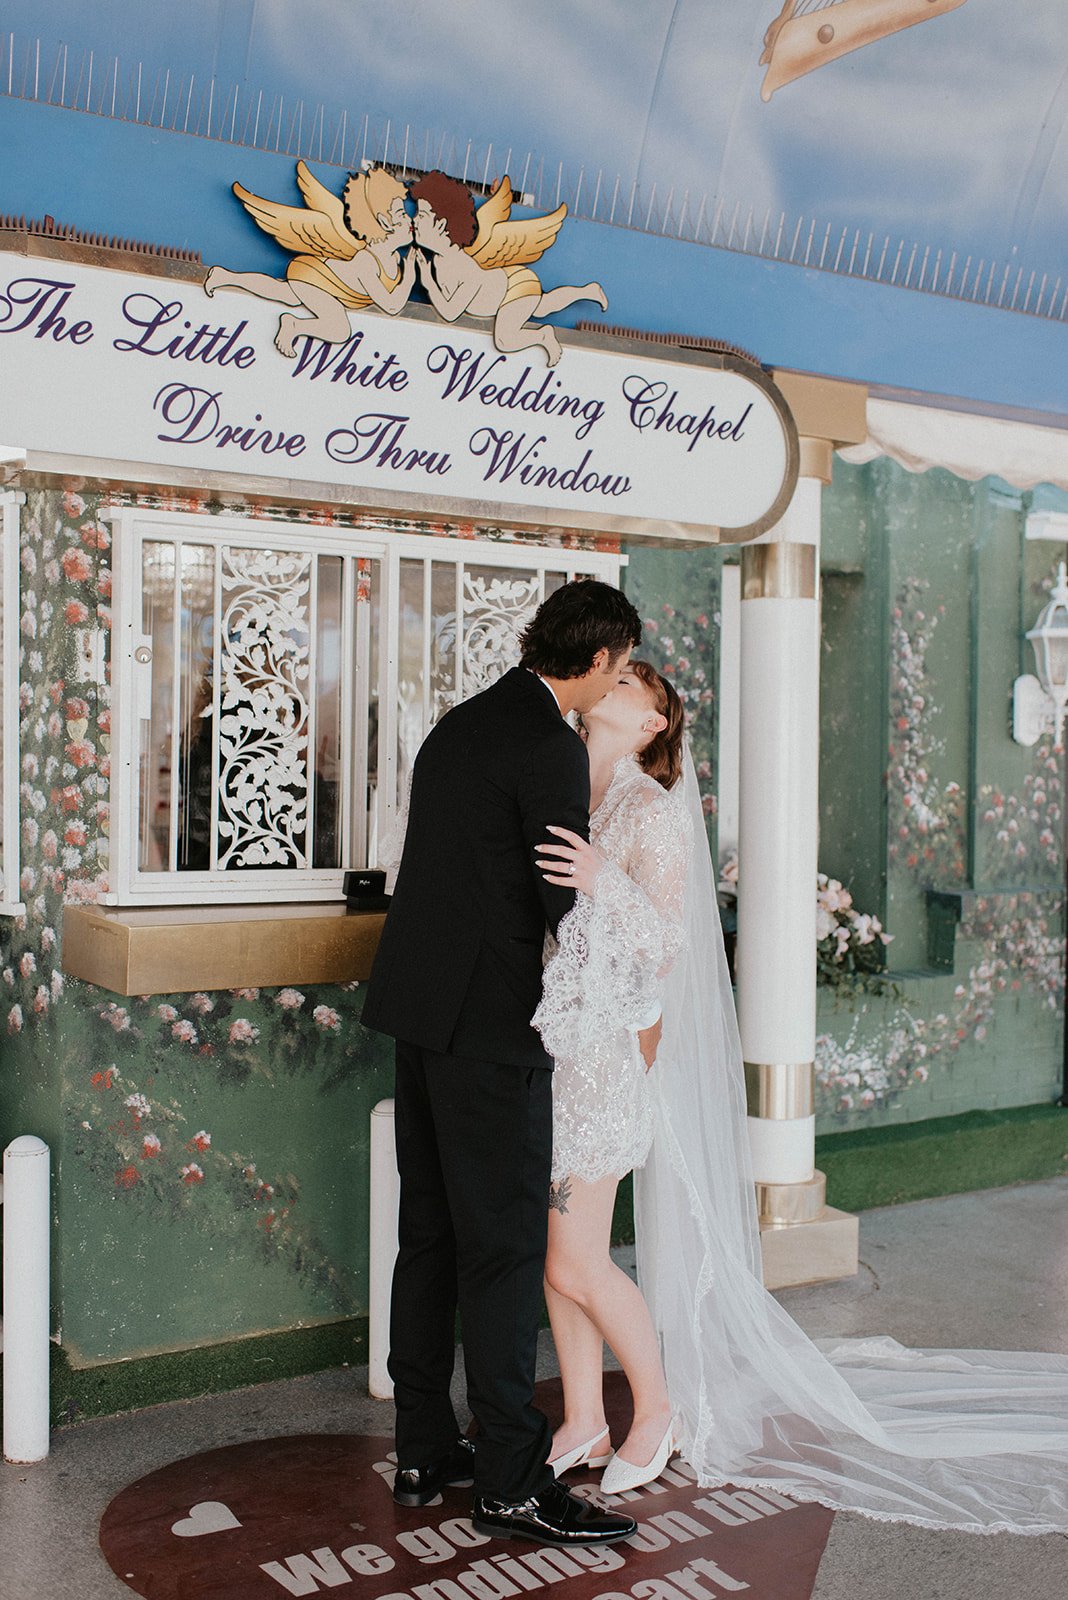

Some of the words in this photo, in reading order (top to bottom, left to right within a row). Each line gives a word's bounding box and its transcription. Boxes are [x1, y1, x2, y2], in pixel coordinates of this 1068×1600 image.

[0, 278, 94, 345] The
[113, 293, 256, 369] Little
[291, 331, 409, 392] White
[426, 345, 605, 440] Wedding
[622, 375, 754, 452] Chapel
[153, 382, 307, 457] Drive
[325, 413, 452, 475] Thru
[469, 426, 632, 497] Window
[258, 1544, 396, 1598] We
[395, 1517, 492, 1564] go
[374, 1546, 627, 1600] nding
[623, 1510, 714, 1553] on
[691, 1487, 800, 1526] thi
[591, 1557, 751, 1600] art
